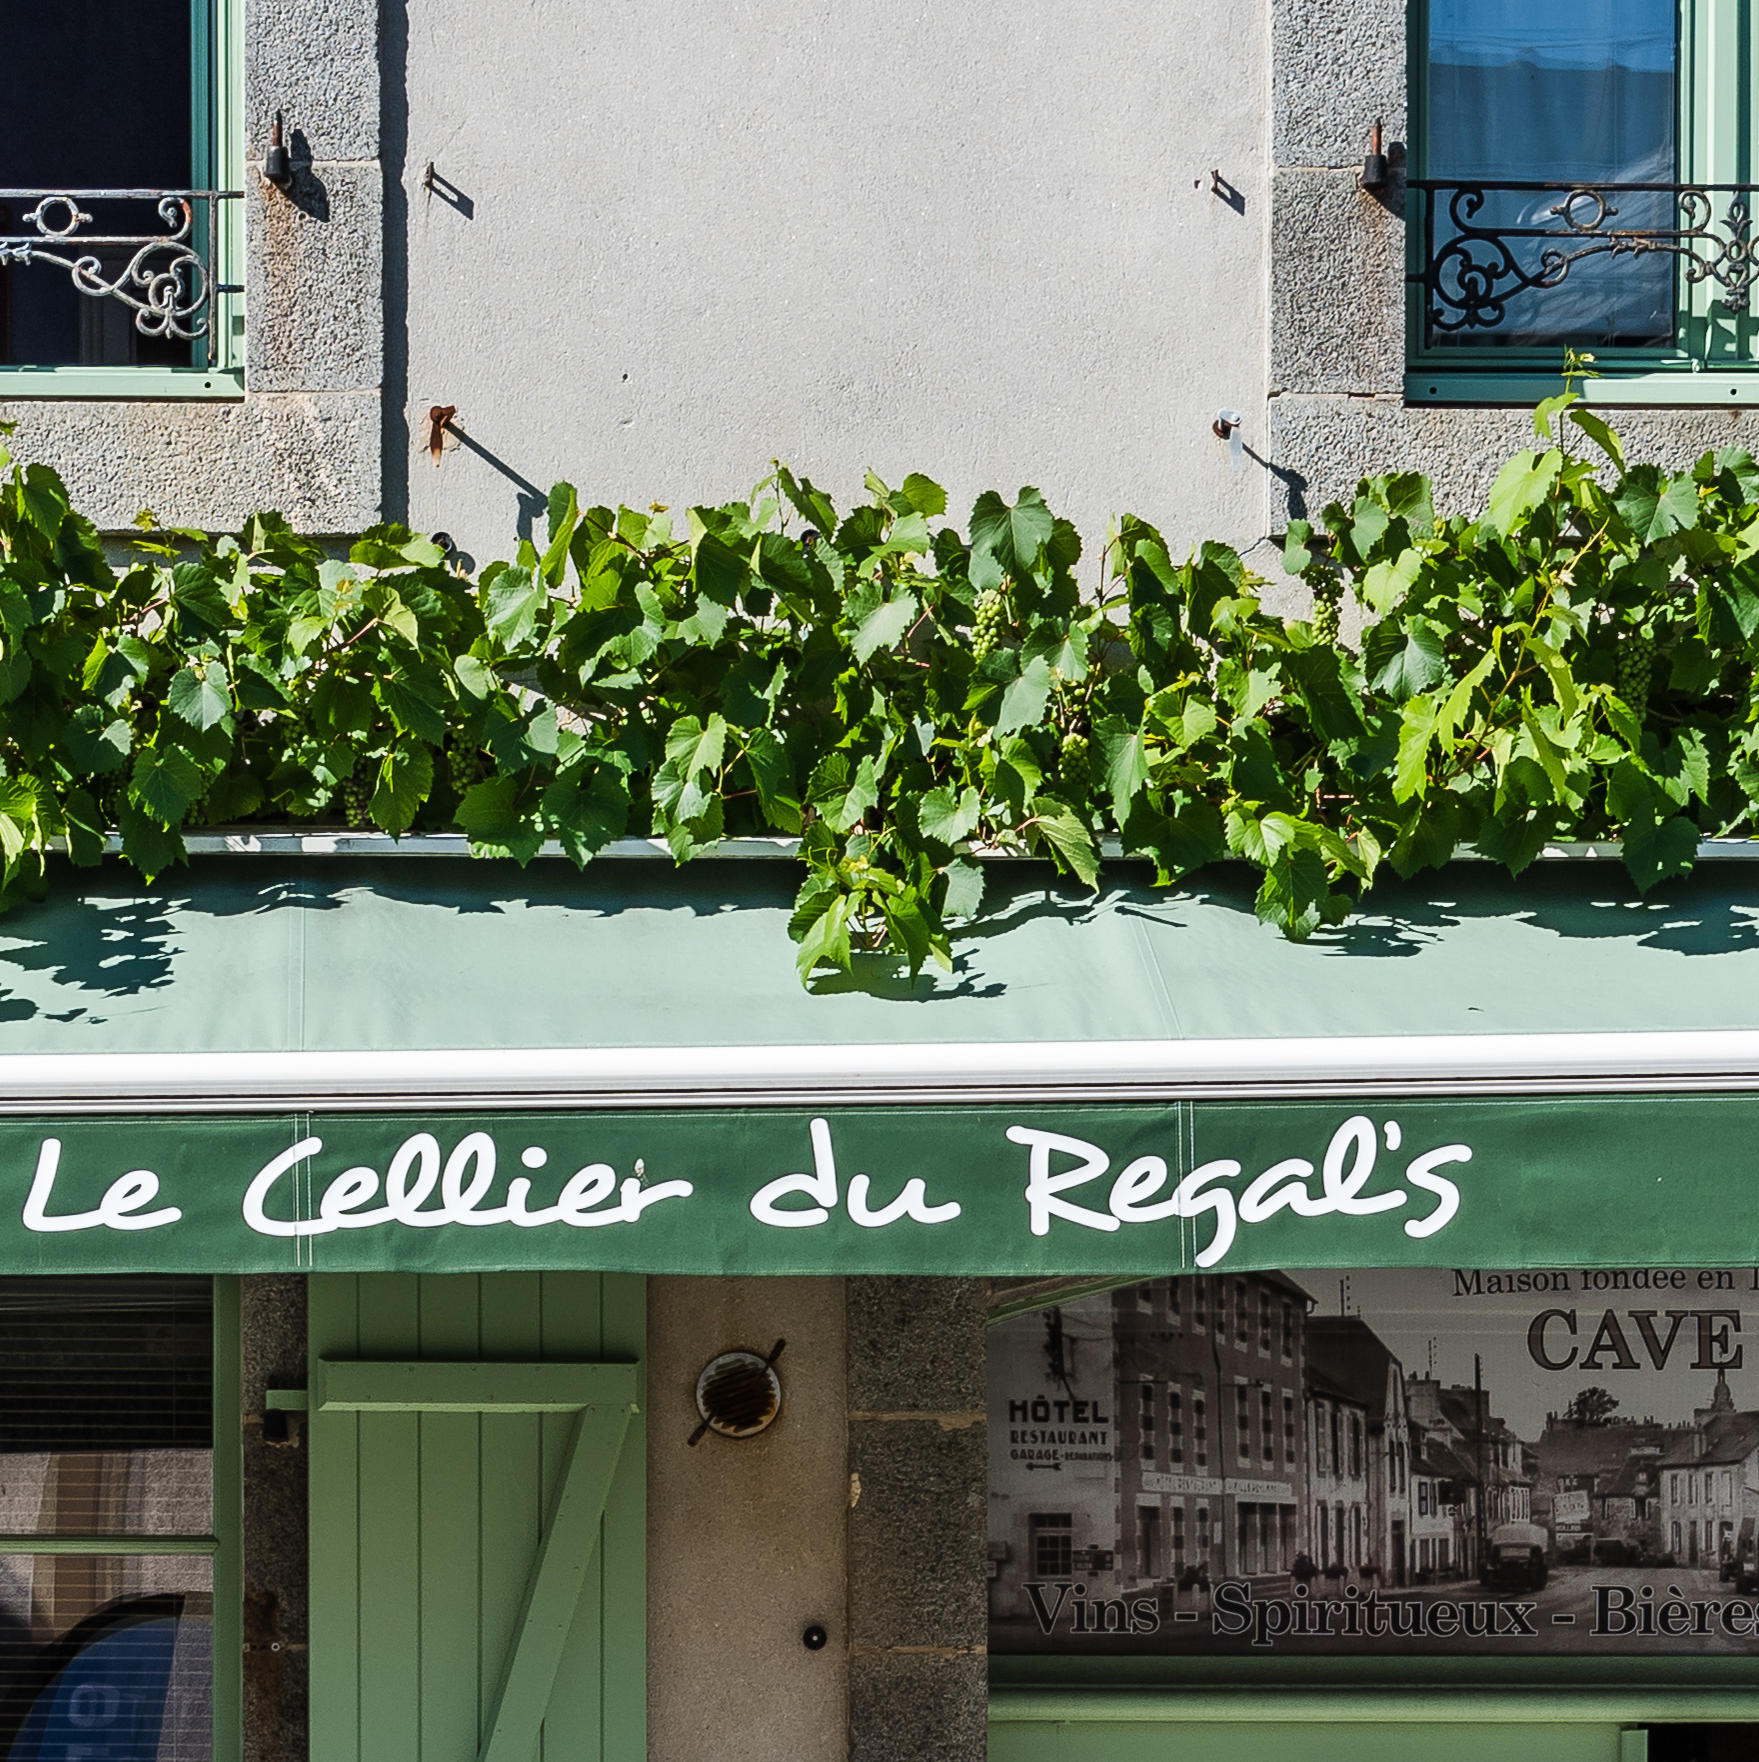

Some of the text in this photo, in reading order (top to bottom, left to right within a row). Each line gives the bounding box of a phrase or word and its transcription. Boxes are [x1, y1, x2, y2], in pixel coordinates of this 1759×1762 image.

[22, 1116, 1473, 1268] Le Cellier du Regal's
[1451, 1268, 1571, 1296] Maison
[1697, 1270, 1736, 1292] en
[1527, 1308, 1743, 1371] CAVE
[1009, 1395, 1109, 1423] HÔTEL
[1010, 1430, 1108, 1446] RESTAURANT
[1022, 1582, 1161, 1635] Vins
[1211, 1582, 1539, 1646] Spiritueux
